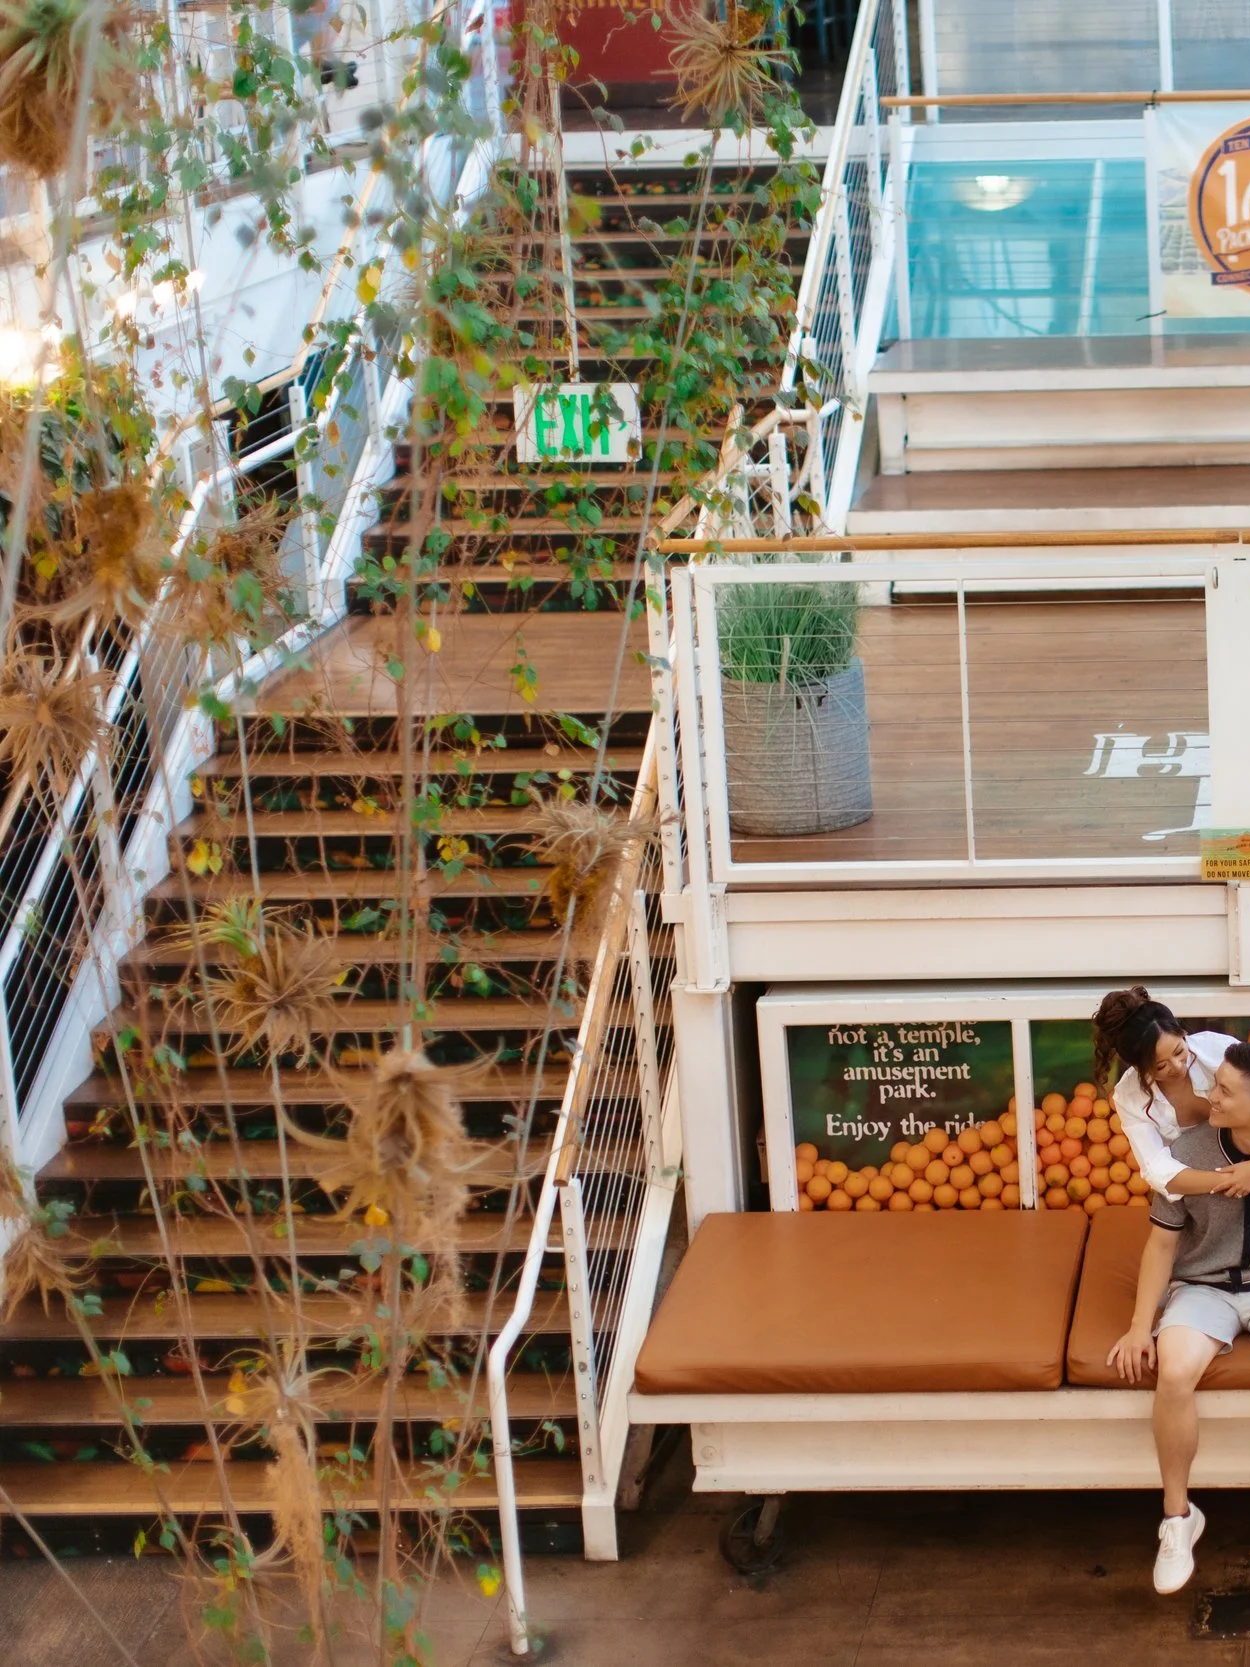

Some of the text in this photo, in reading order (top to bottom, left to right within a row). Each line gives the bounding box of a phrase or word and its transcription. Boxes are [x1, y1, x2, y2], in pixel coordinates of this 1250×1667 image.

[1227, 139, 1250, 151] TEN
[1205, 859, 1218, 867] FOR
[1220, 859, 1237, 867] YOUR
[1232, 870, 1250, 878] MOVE
[828, 1028, 868, 1045] not
[897, 1023, 981, 1049] temple,
[913, 1047, 939, 1062] an
[843, 1063, 971, 1081] amusement
[879, 1073, 937, 1104] park.
[826, 1113, 891, 1141] Enjoy
[900, 1112, 936, 1135] the
